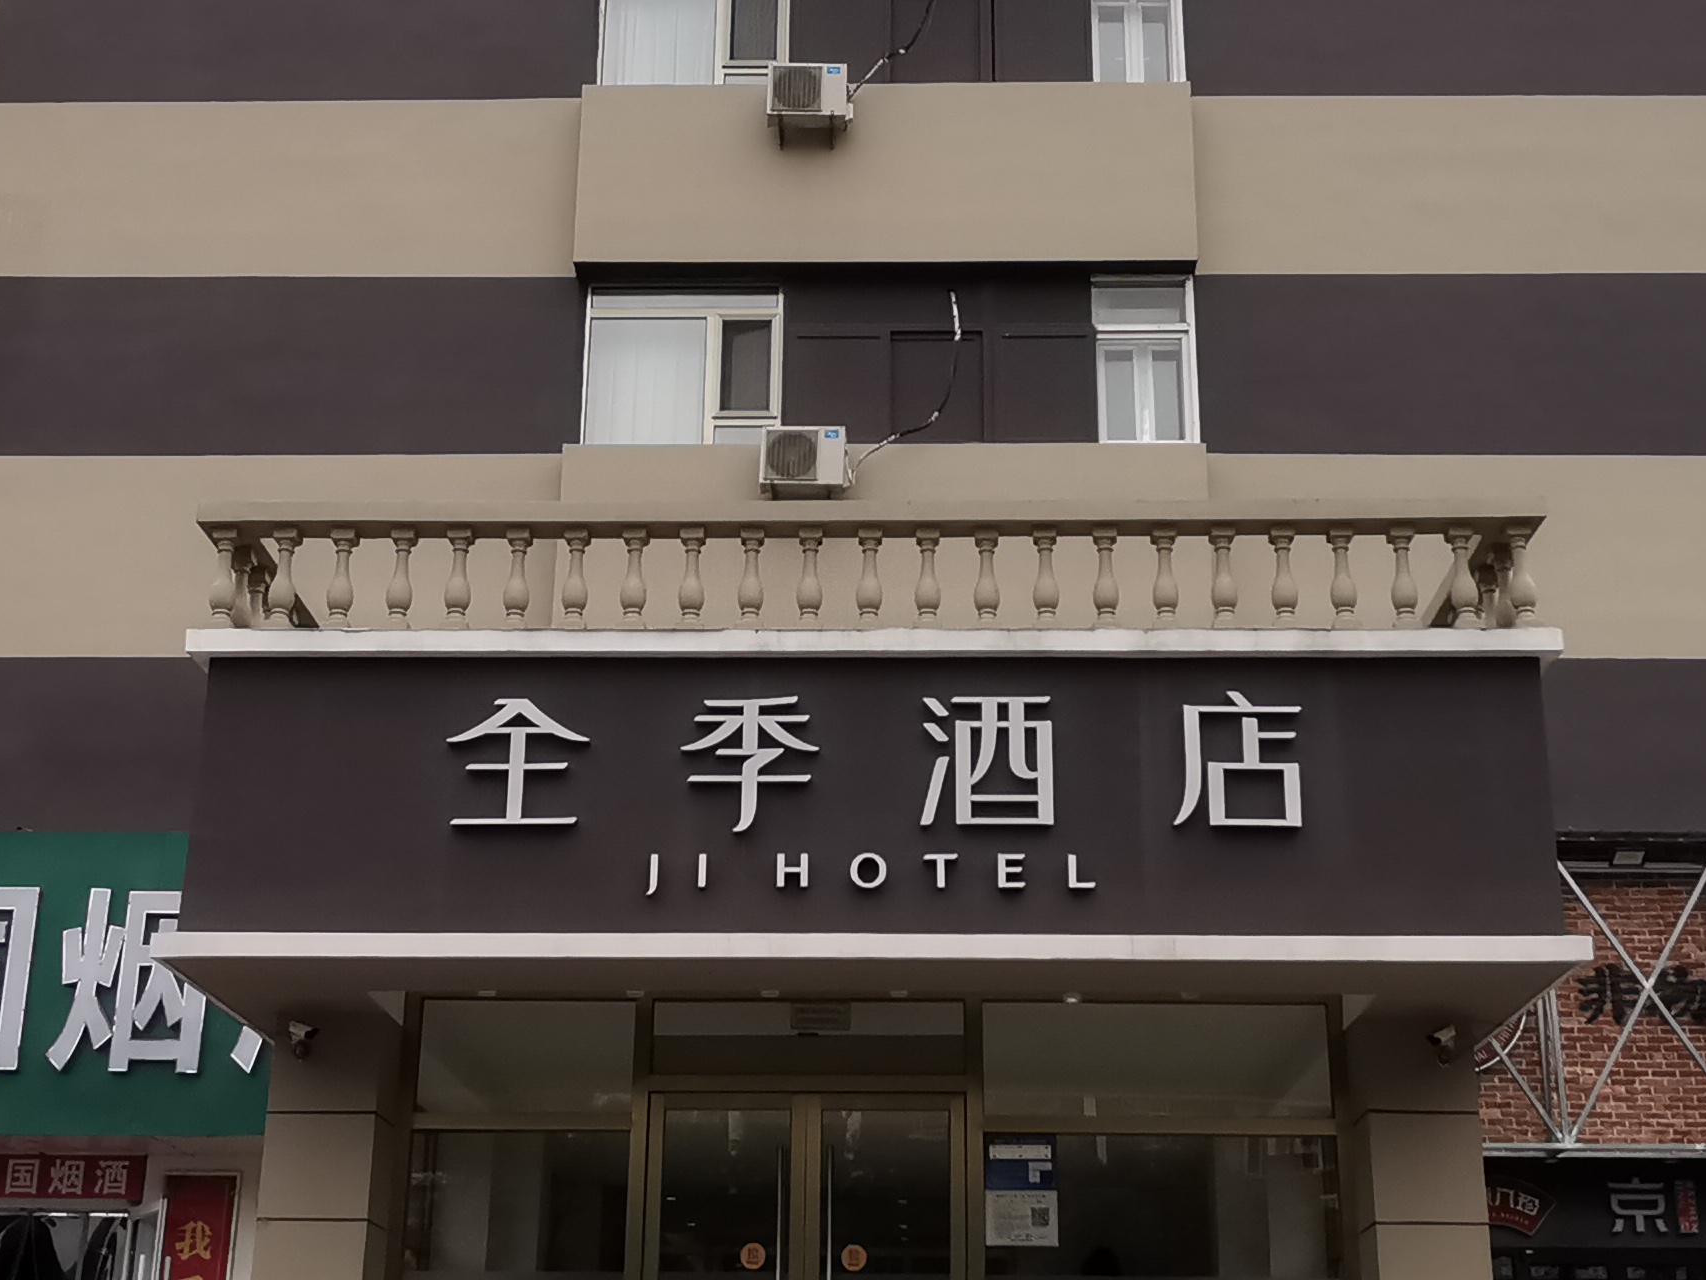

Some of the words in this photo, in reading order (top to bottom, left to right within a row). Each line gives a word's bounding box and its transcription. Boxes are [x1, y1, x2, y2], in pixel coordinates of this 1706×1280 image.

[446, 690, 1304, 834] 全季酒店
[645, 852, 709, 897] JI
[775, 852, 1097, 890] HOTEL
[1488, 1186, 1541, 1217] 八珍
